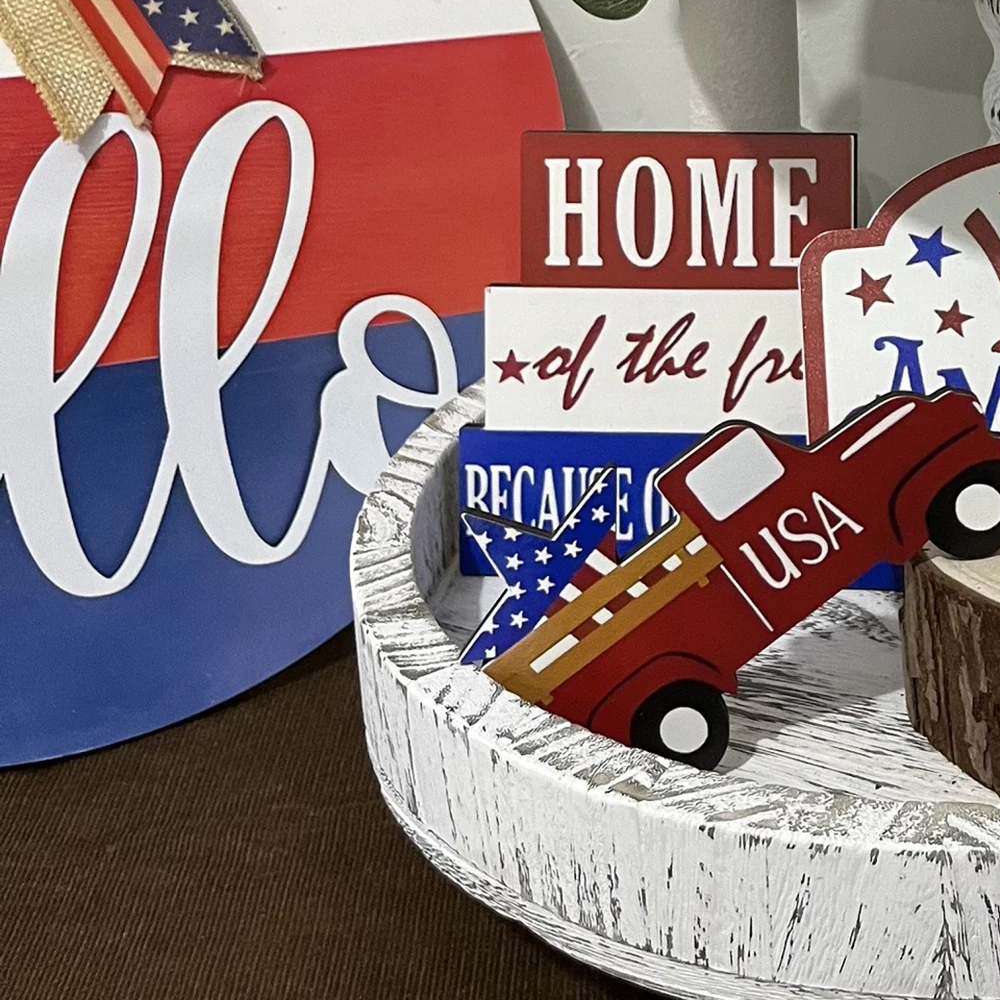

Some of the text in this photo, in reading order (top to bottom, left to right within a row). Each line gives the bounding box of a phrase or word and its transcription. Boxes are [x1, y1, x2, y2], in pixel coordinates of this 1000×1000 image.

[544, 157, 818, 268] HOME
[0, 99, 458, 598] llo
[532, 314, 607, 411] of
[616, 311, 710, 384] the
[464, 463, 634, 541] BECAUE
[738, 491, 864, 589] USA
